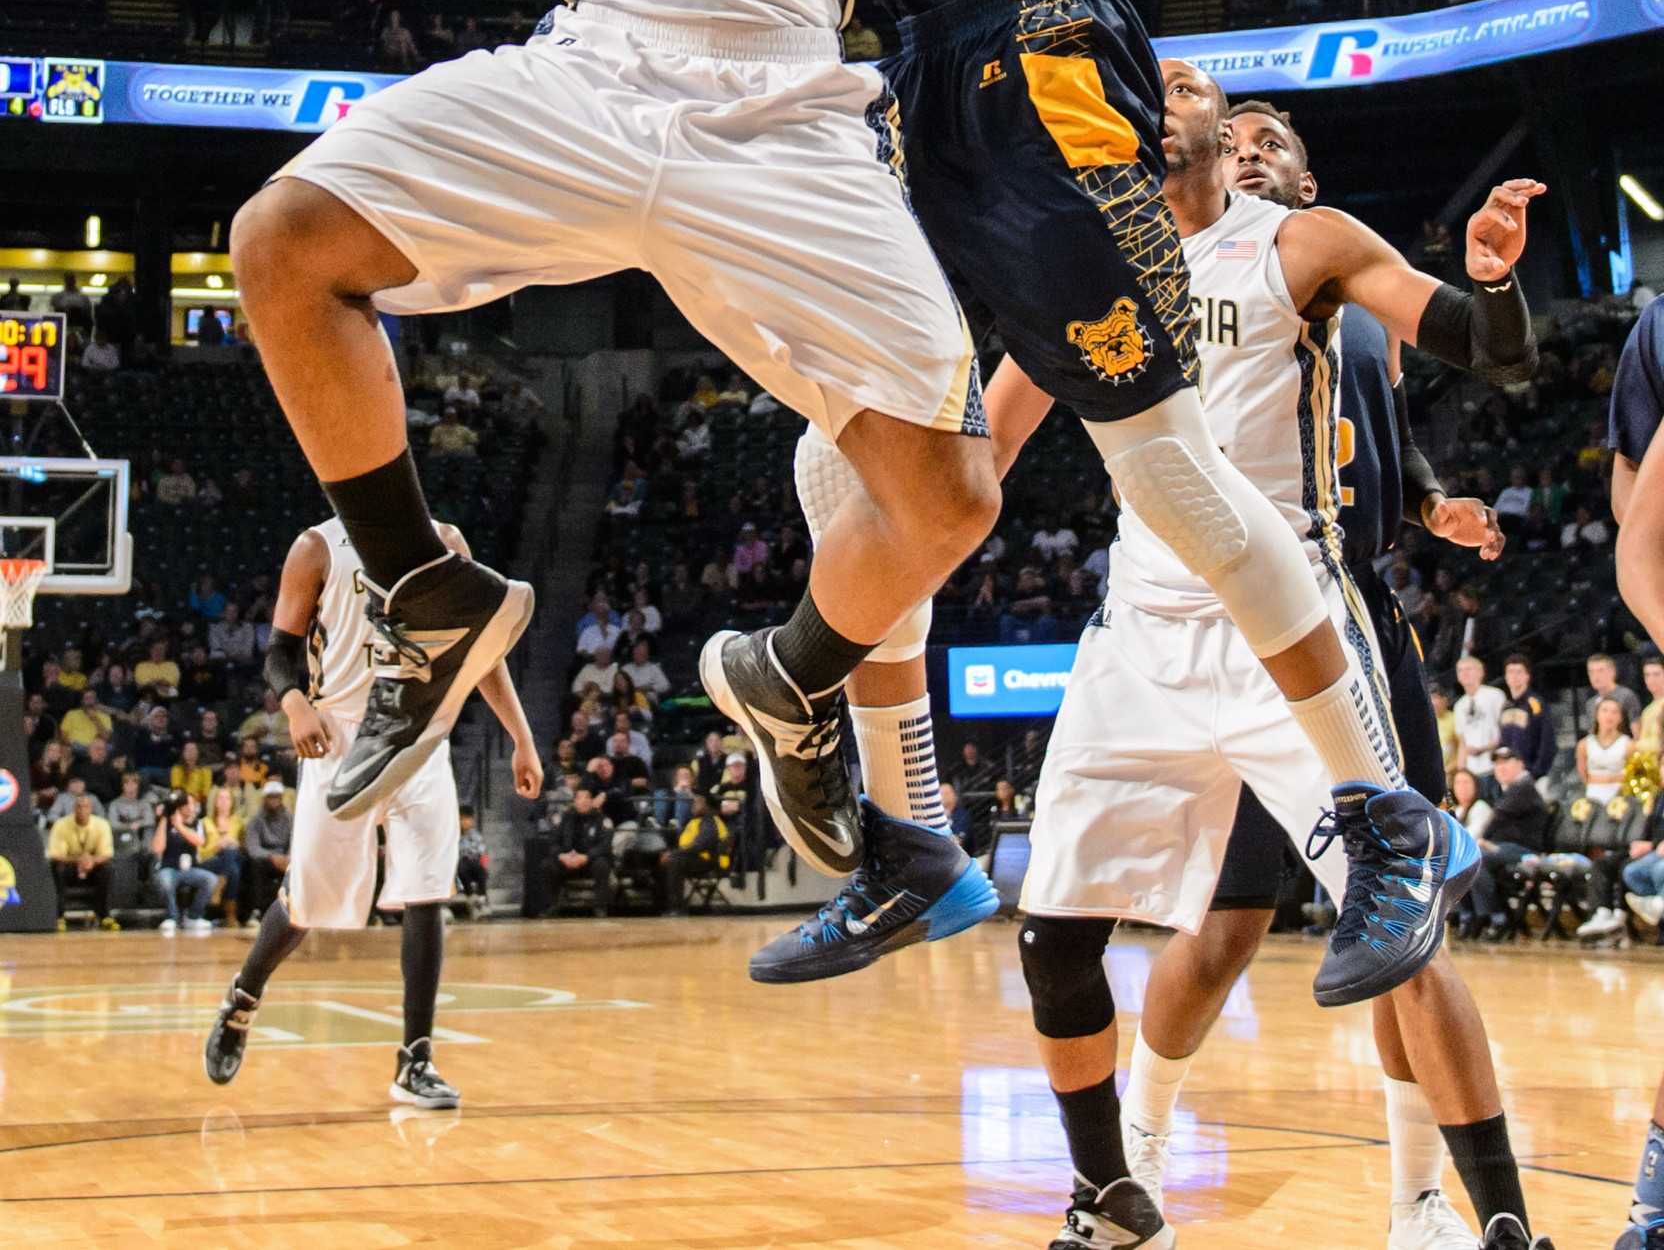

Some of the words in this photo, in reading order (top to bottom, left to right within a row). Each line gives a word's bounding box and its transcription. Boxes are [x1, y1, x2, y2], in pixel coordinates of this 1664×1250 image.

[1271, 49, 1303, 66] WE
[143, 84, 255, 106] TOGETHER
[260, 90, 294, 107] WE
